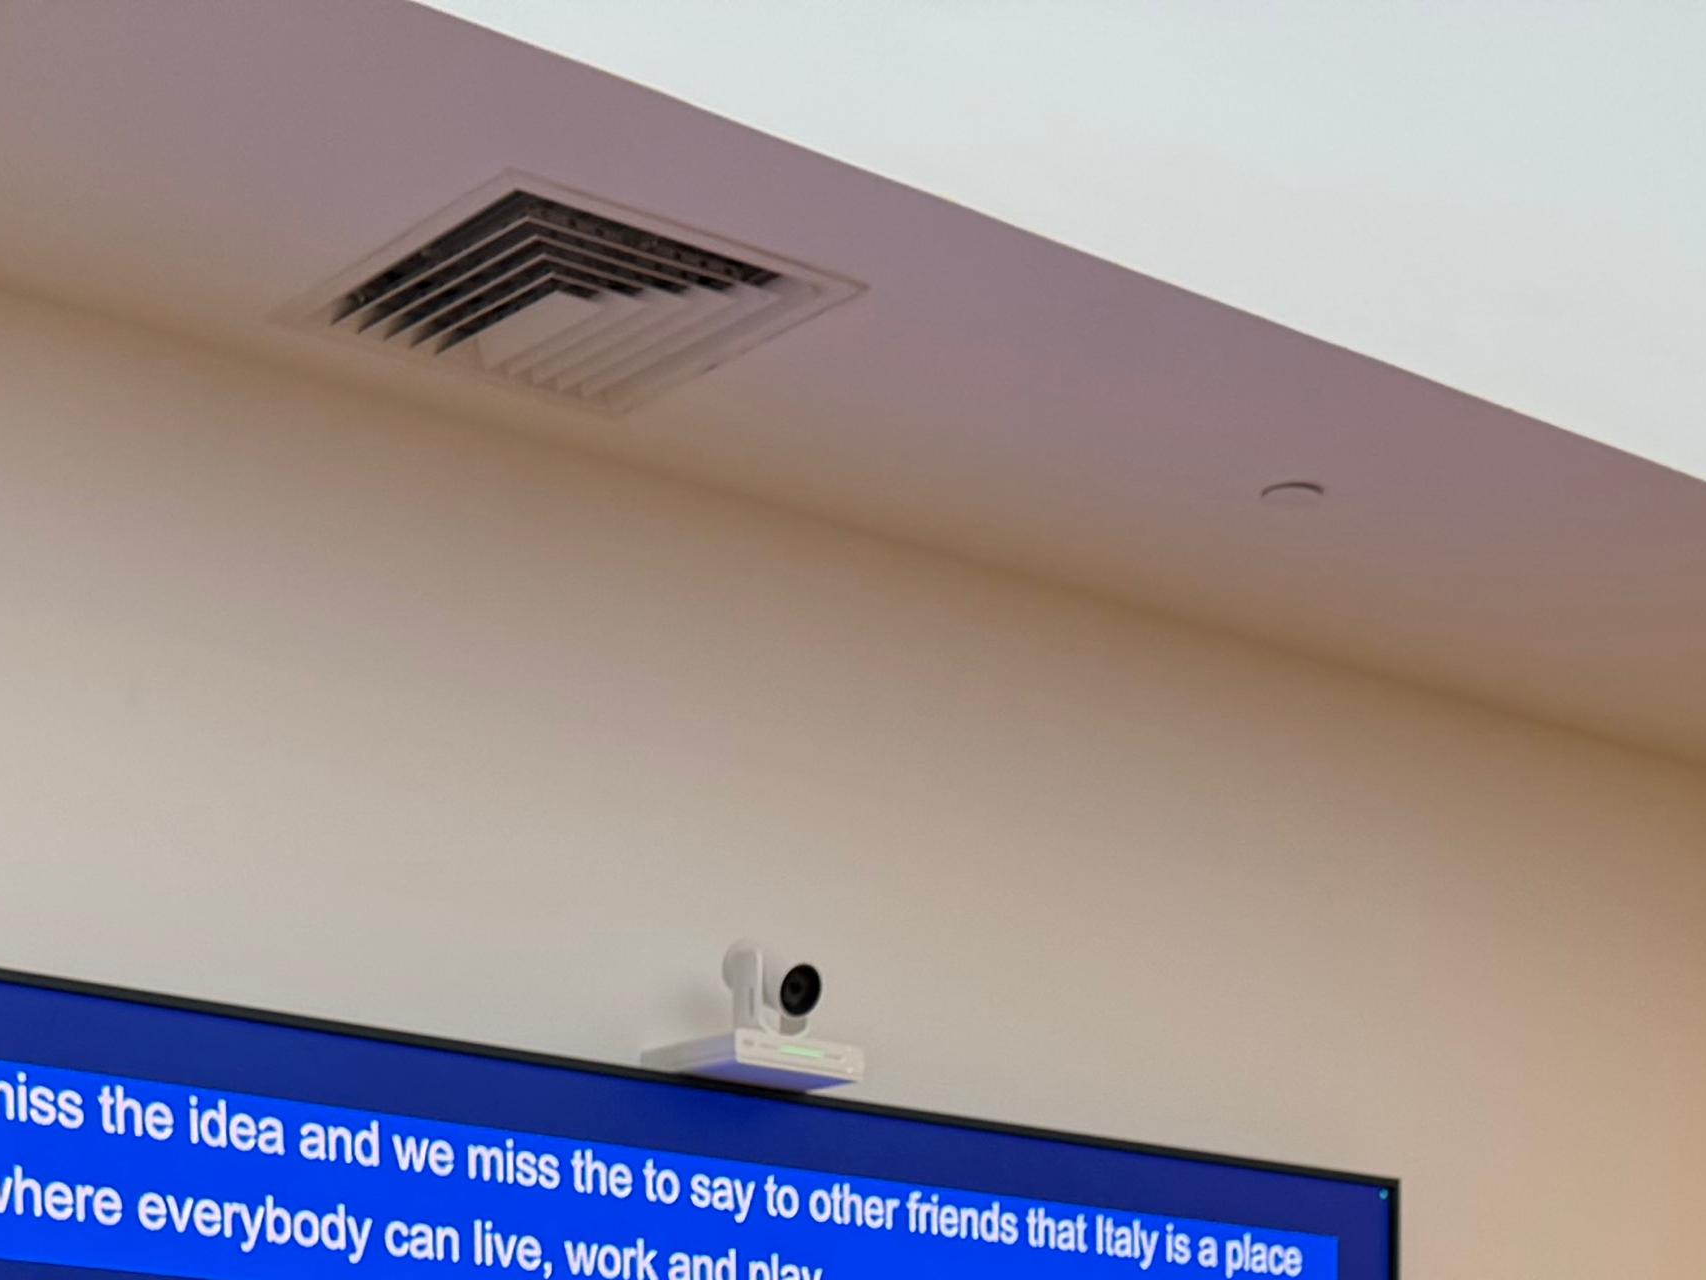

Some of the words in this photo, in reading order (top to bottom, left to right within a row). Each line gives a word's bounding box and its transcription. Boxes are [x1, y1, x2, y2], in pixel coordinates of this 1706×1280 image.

[97, 1085, 174, 1141] the
[189, 1095, 286, 1156] idea
[299, 1120, 380, 1167] and
[392, 1134, 455, 1177] we
[467, 1138, 561, 1190] miss
[571, 1149, 633, 1199] the
[642, 1159, 681, 1205] to
[690, 1174, 756, 1224] say
[764, 1175, 800, 1219] to
[809, 1183, 900, 1230] other
[906, 1191, 1019, 1245] friends
[1026, 1207, 1088, 1253] that
[1096, 1215, 1159, 1270] Italy
[1166, 1224, 1192, 1265] is
[1197, 1236, 1218, 1268] a
[1225, 1232, 1304, 1279] place
[137, 1194, 373, 1264] everybody
[384, 1220, 460, 1263] can
[473, 1219, 553, 1280] live,
